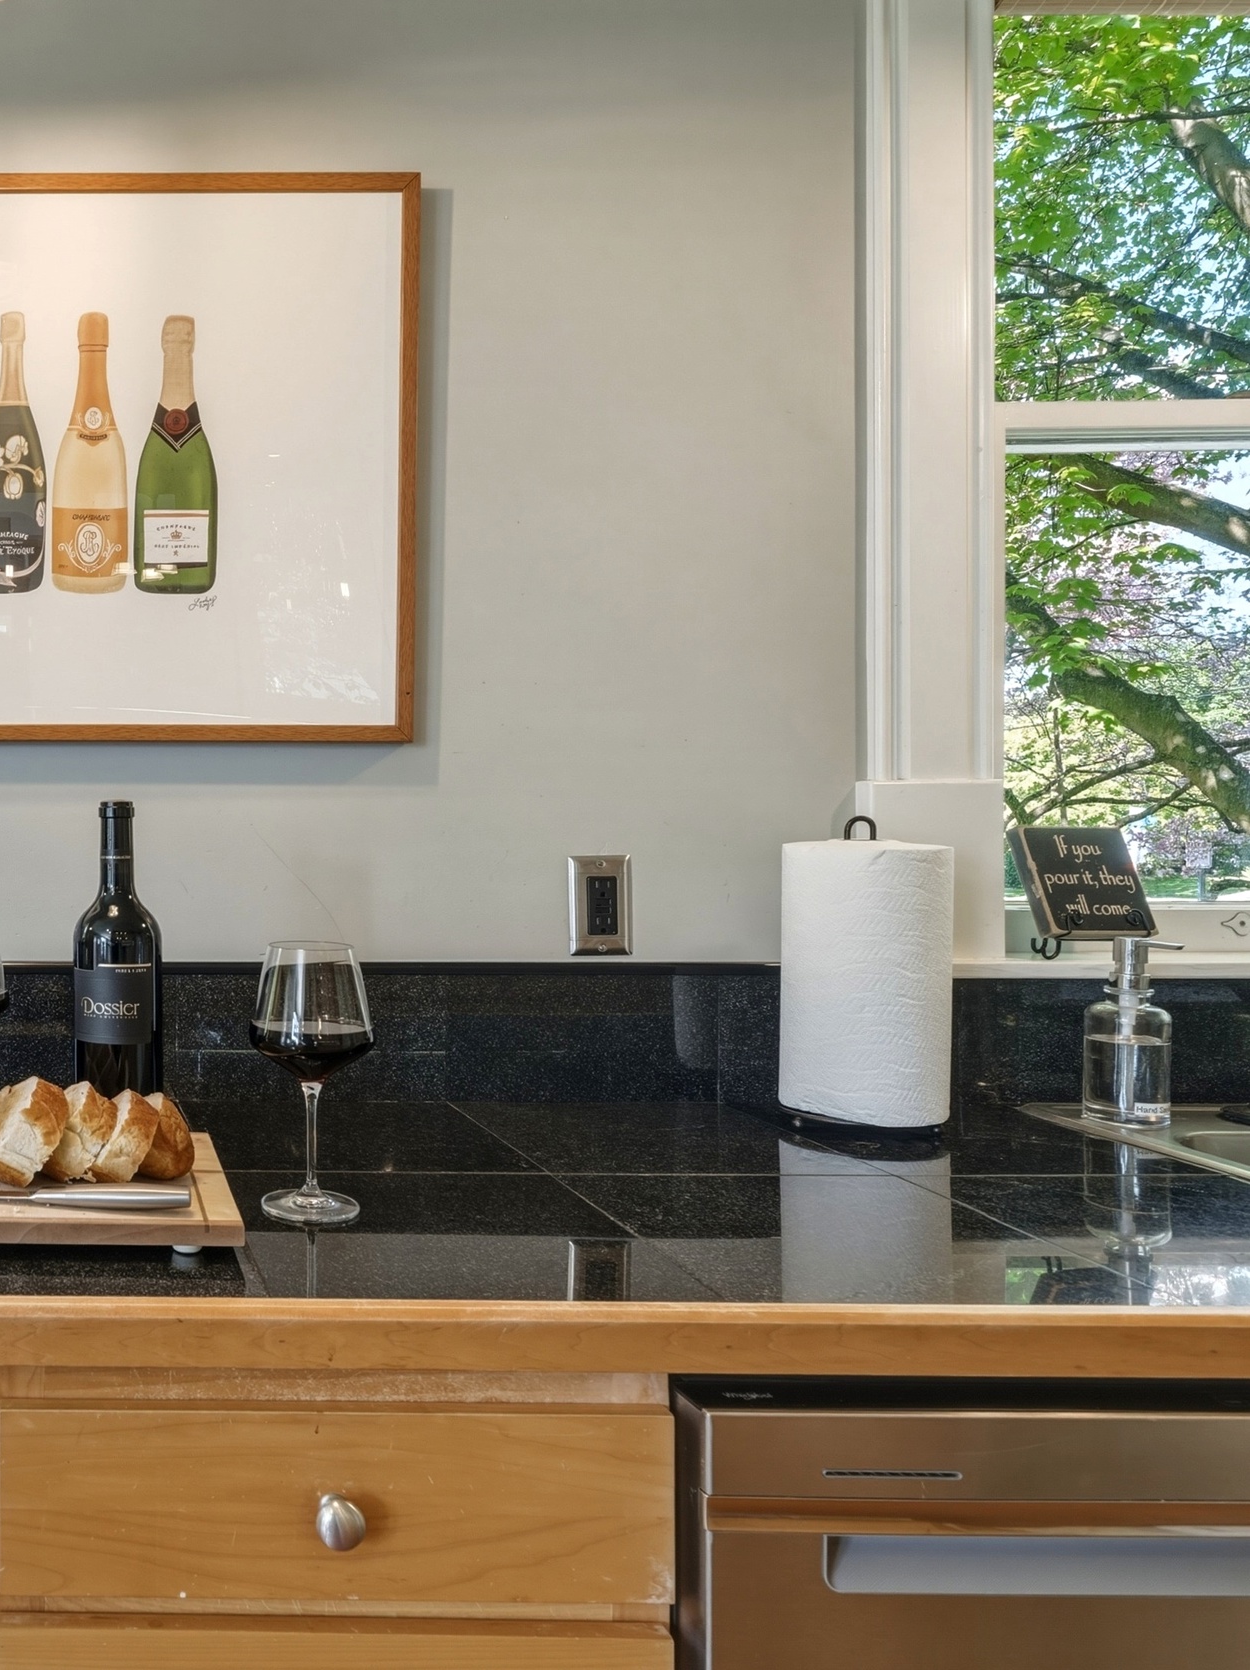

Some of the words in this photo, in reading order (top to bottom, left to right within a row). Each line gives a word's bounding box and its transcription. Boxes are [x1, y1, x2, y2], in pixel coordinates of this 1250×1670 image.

[1053, 834, 1068, 858] If
[1071, 844, 1102, 863] you
[1043, 873, 1080, 894] pour
[1081, 868, 1099, 889] it,
[1098, 865, 1136, 894] they
[1065, 894, 1091, 915] will
[81, 996, 140, 1016] Dossier
[1136, 1106, 1158, 1114] Hand
